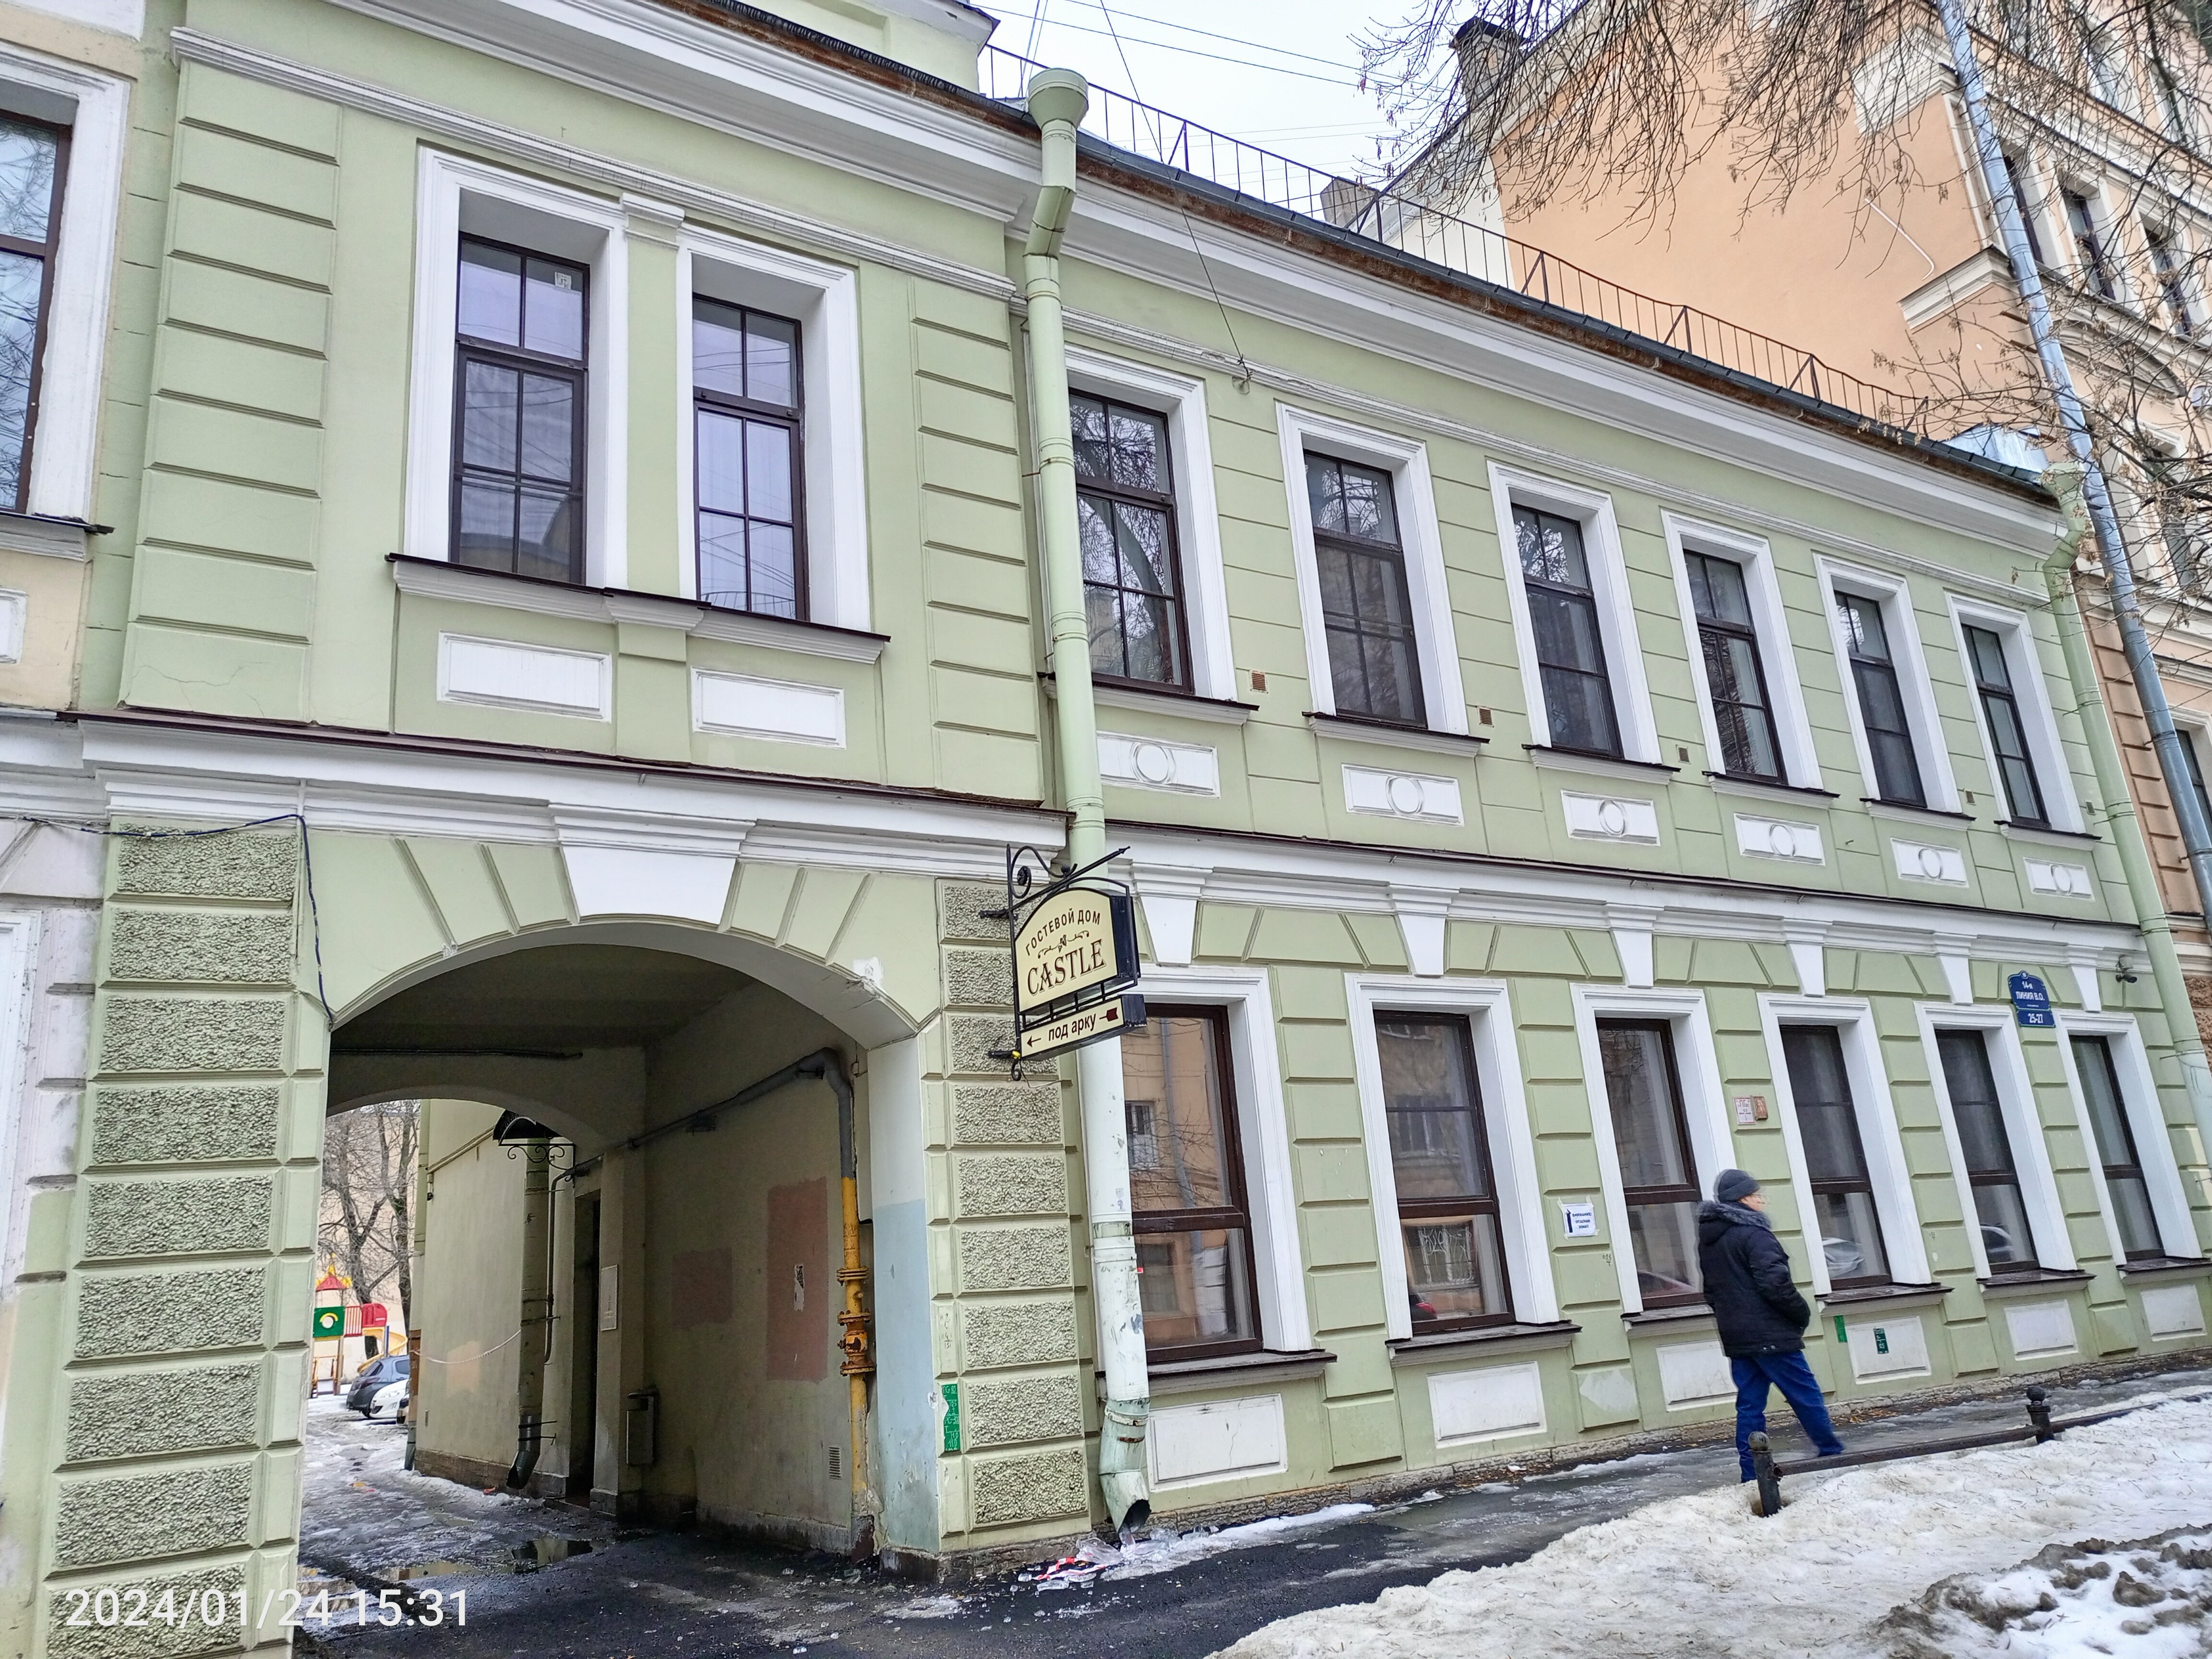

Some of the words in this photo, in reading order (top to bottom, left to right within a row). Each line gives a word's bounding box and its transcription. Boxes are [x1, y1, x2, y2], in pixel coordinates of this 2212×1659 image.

[1025, 908, 1074, 956] ГОСТЕВОЙ
[1077, 910, 1100, 926] ДОМ
[1027, 938, 1106, 995] CASTLE
[2015, 991, 2034, 1000] ЛИНИЯ
[1048, 1024, 1068, 1041] под
[1071, 1013, 1096, 1035] арку
[2028, 1013, 2044, 1023] 25-27
